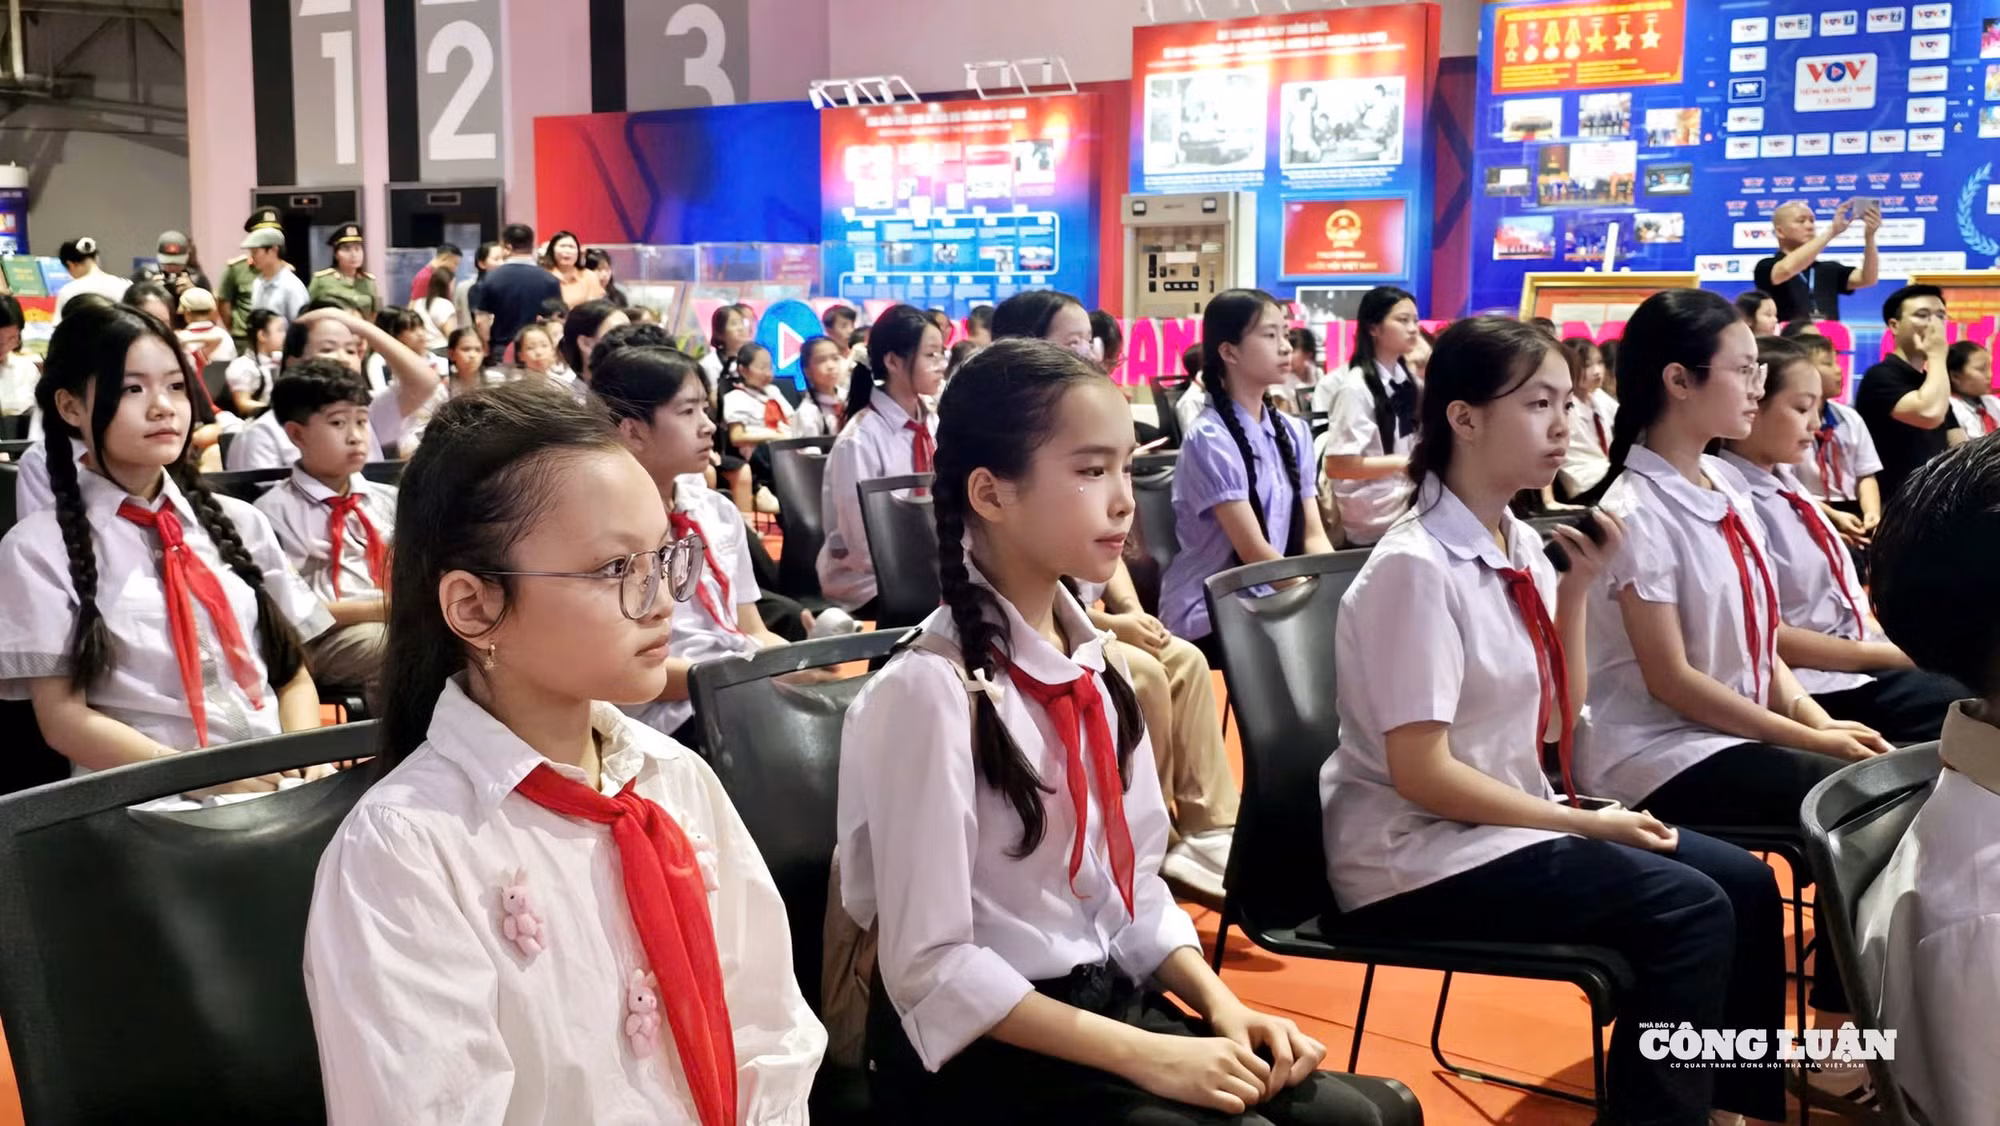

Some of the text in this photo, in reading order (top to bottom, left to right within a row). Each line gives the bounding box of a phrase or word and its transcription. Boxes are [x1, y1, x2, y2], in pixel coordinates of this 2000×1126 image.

[321, 31, 356, 164] 1
[427, 20, 496, 160] 2
[665, 3, 735, 105] 3
[1806, 60, 1866, 83] VOV
